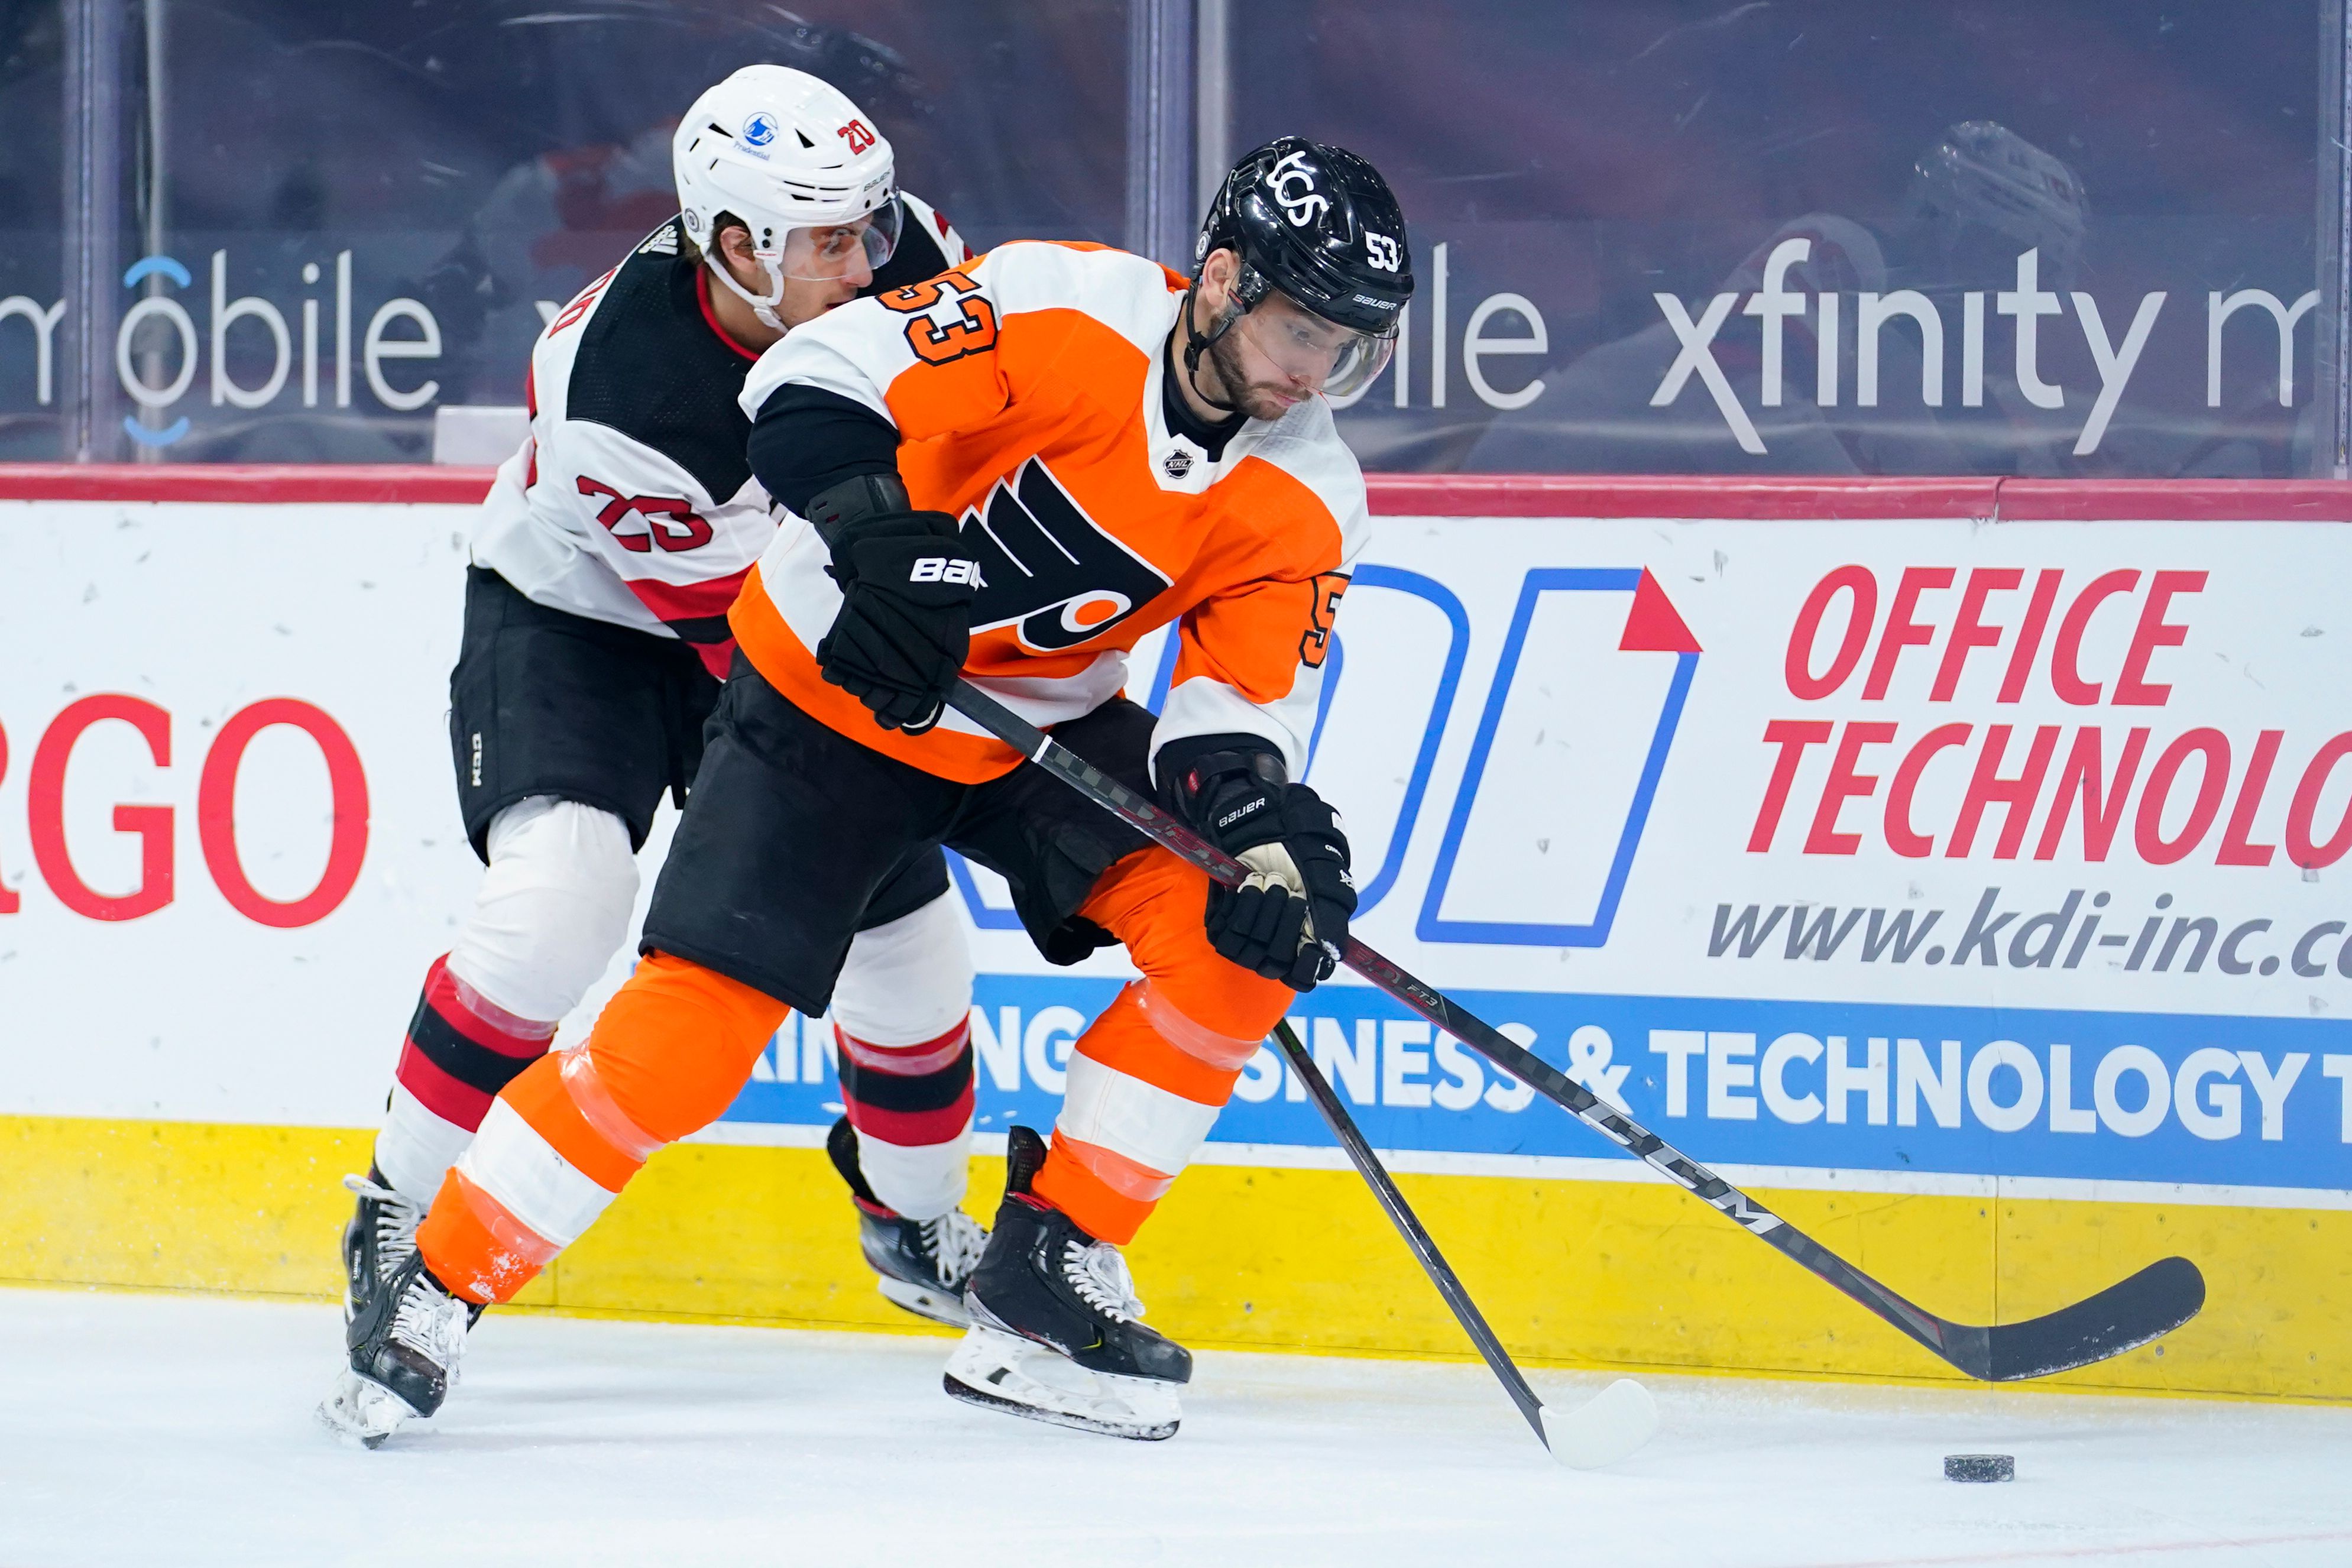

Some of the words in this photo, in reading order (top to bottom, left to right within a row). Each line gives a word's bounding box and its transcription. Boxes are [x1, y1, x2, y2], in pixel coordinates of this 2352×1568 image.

[837, 119, 876, 155] 20
[1365, 231, 1401, 273] 53
[875, 271, 998, 367] 53
[1352, 294, 1397, 310] BAUER
[1167, 459, 1188, 469] NHL
[1785, 563, 2210, 707] OFFICE
[1219, 797, 1266, 828] BAUER
[1746, 720, 2352, 870] TECHNOLO
[1707, 886, 2352, 979] www.kdi-inc.c
[1407, 984, 1438, 1007] FT3
[1648, 1029, 2310, 1141] TECHNOLOGY
[1579, 1100, 1785, 1235] CCM
